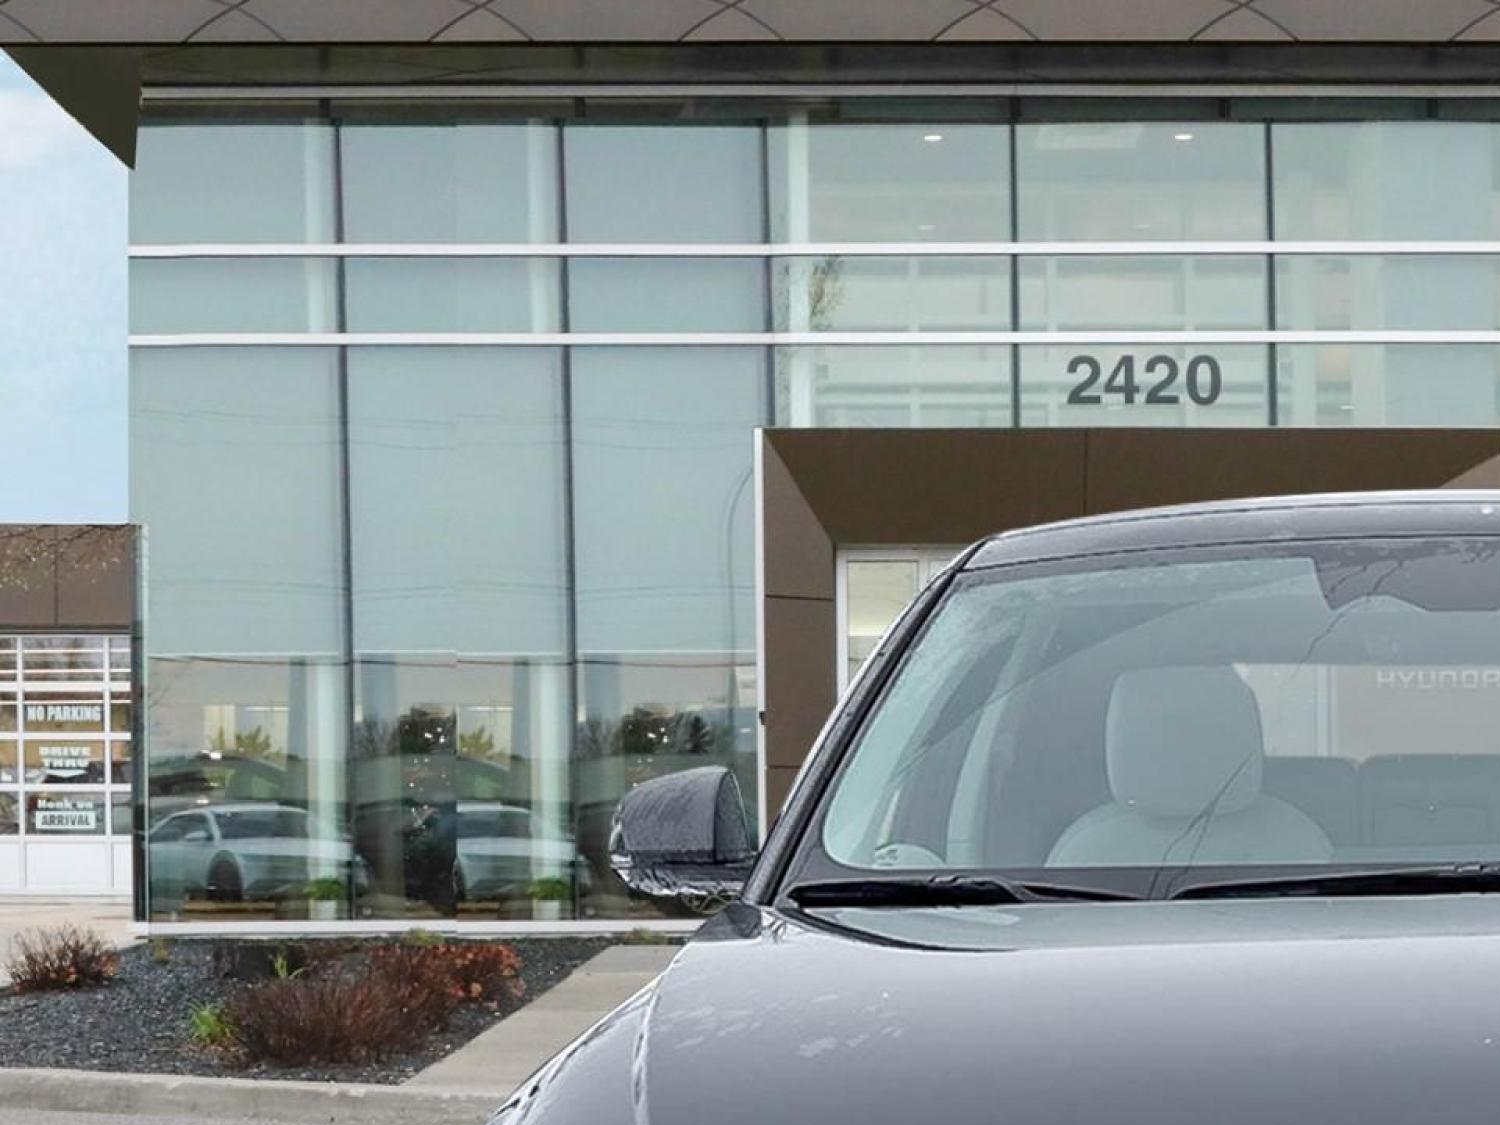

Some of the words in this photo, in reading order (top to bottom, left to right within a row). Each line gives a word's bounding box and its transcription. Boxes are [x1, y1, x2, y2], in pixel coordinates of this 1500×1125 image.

[1066, 354, 1223, 405] 2420
[27, 705, 45, 721] NO
[47, 705, 101, 721] PARKING
[39, 746, 91, 756] DRIVE
[41, 813, 91, 826] ARRIVAL
